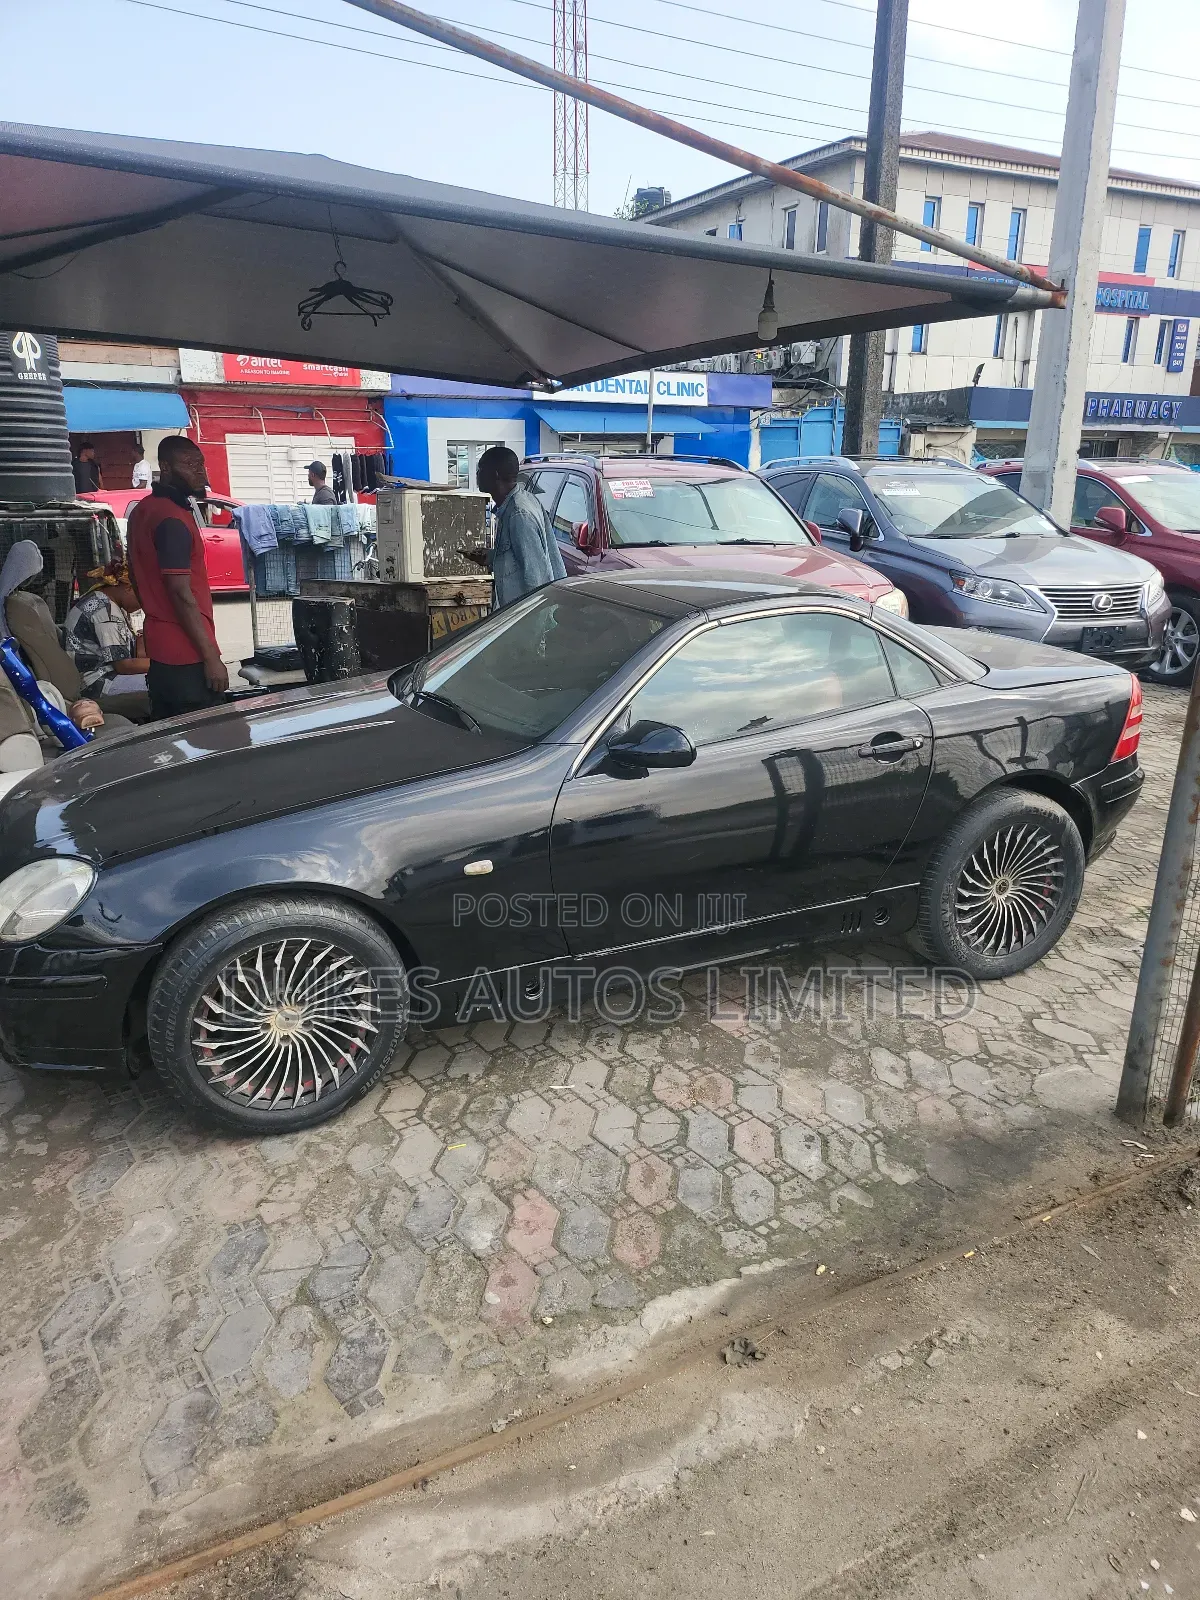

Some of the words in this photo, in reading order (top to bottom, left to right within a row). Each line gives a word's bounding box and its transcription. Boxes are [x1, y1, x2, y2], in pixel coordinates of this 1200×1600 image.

[1096, 287, 1150, 310] HOSPITAL
[251, 356, 282, 367] airtel
[594, 377, 650, 395] DENTAL
[656, 380, 705, 398] CLINIC
[1086, 397, 1183, 420] PHARMACY
